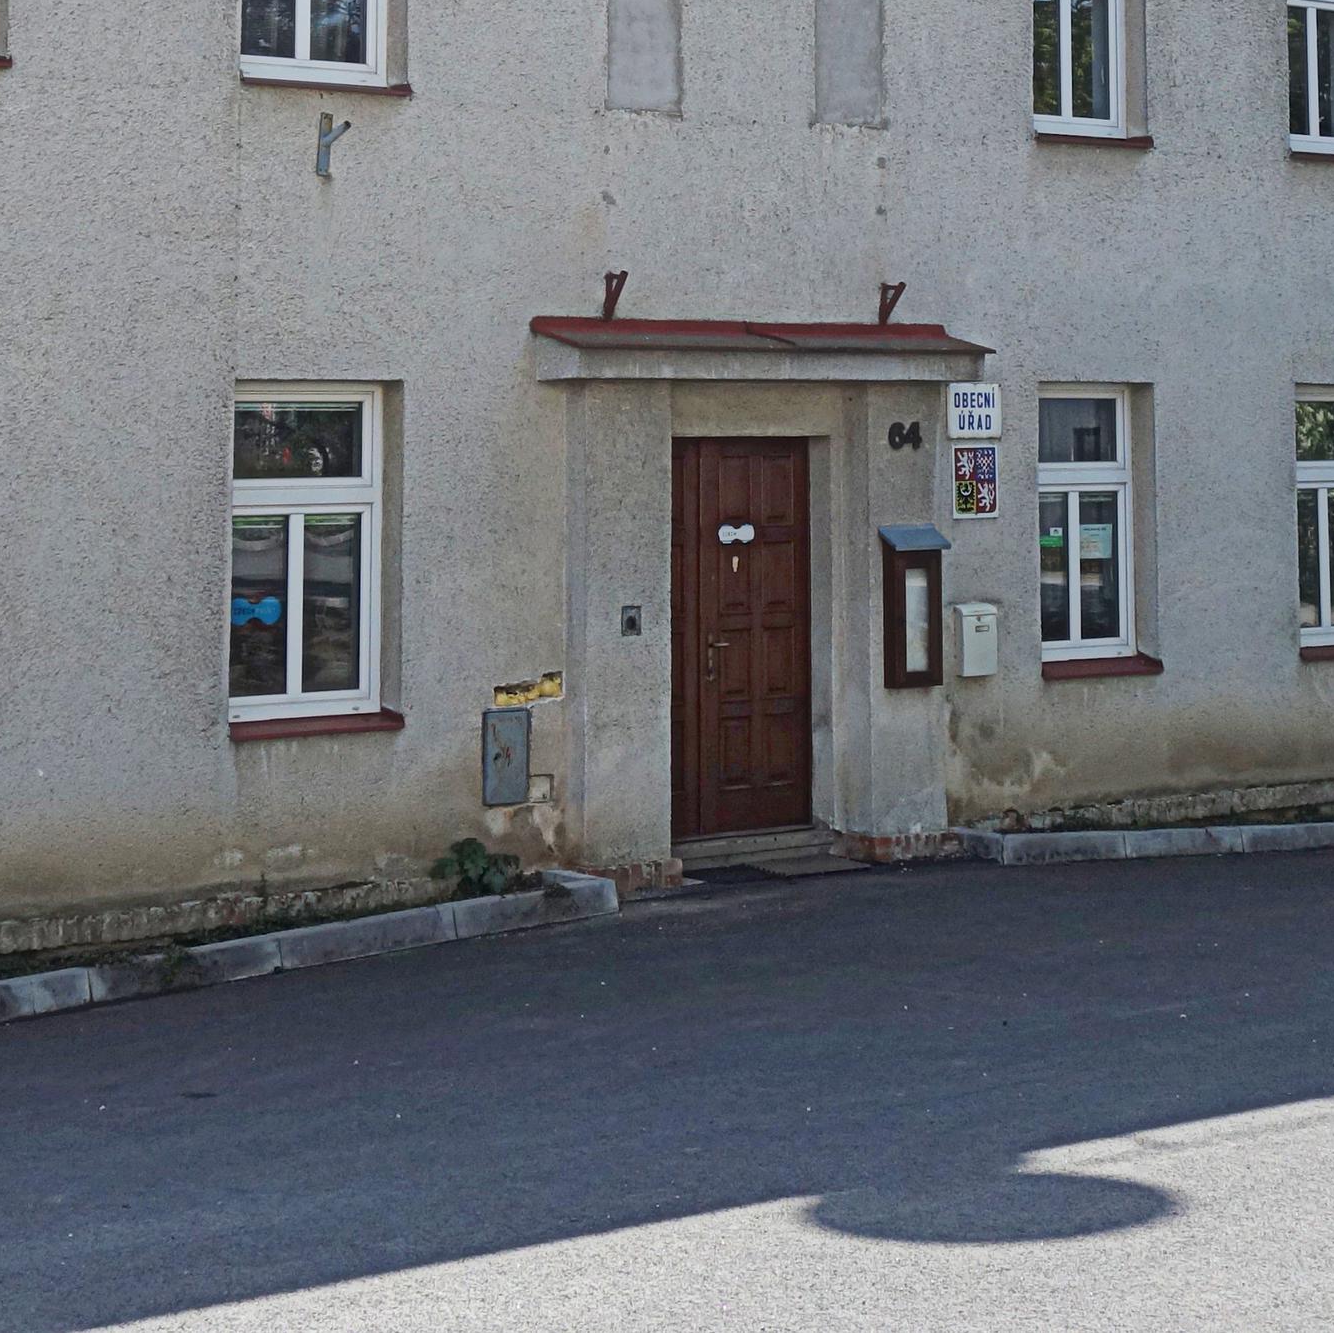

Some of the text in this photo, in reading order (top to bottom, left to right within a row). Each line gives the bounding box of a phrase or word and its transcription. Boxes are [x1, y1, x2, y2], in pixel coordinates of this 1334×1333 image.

[954, 386, 995, 408] OBECNÍ
[958, 410, 992, 430] ÚŘAD
[888, 421, 923, 451] 64
